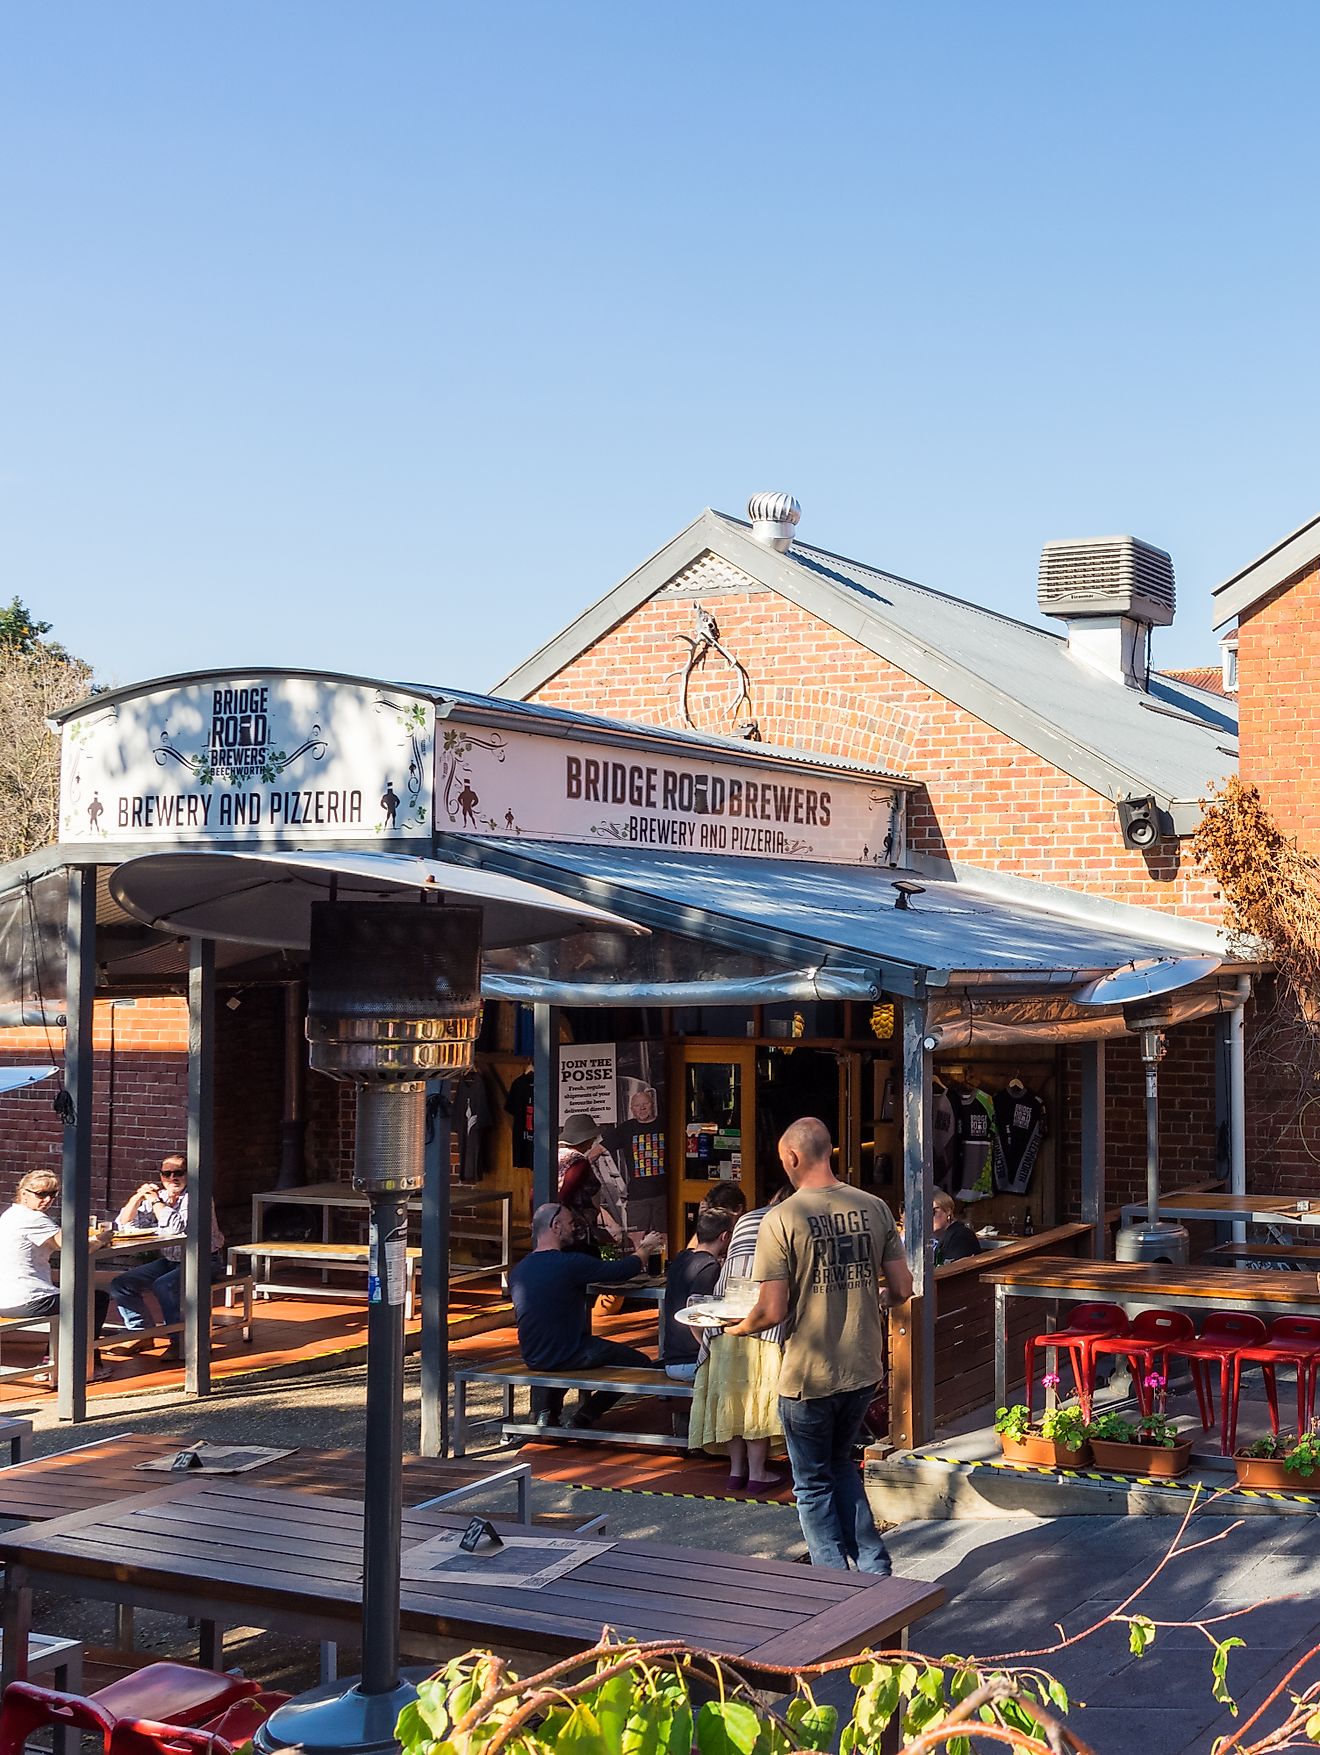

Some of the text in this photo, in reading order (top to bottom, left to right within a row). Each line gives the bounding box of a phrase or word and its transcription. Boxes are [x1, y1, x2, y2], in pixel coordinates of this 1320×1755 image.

[213, 688, 268, 715] BRIDGE
[211, 747, 266, 767] BREWERS
[210, 765, 266, 776] BEECHWORTH
[566, 755, 658, 809] BRIDGE
[728, 778, 832, 828] BREWERS
[118, 790, 362, 828] BREWERY AND PIZZERIA
[629, 816, 785, 854] BREWERY AND PIZZERIA
[561, 1059, 612, 1071] JOIN THE
[561, 1068, 613, 1083] POSSE
[807, 1210, 871, 1239] BRIDGE
[173, 1453, 192, 1468] 25
